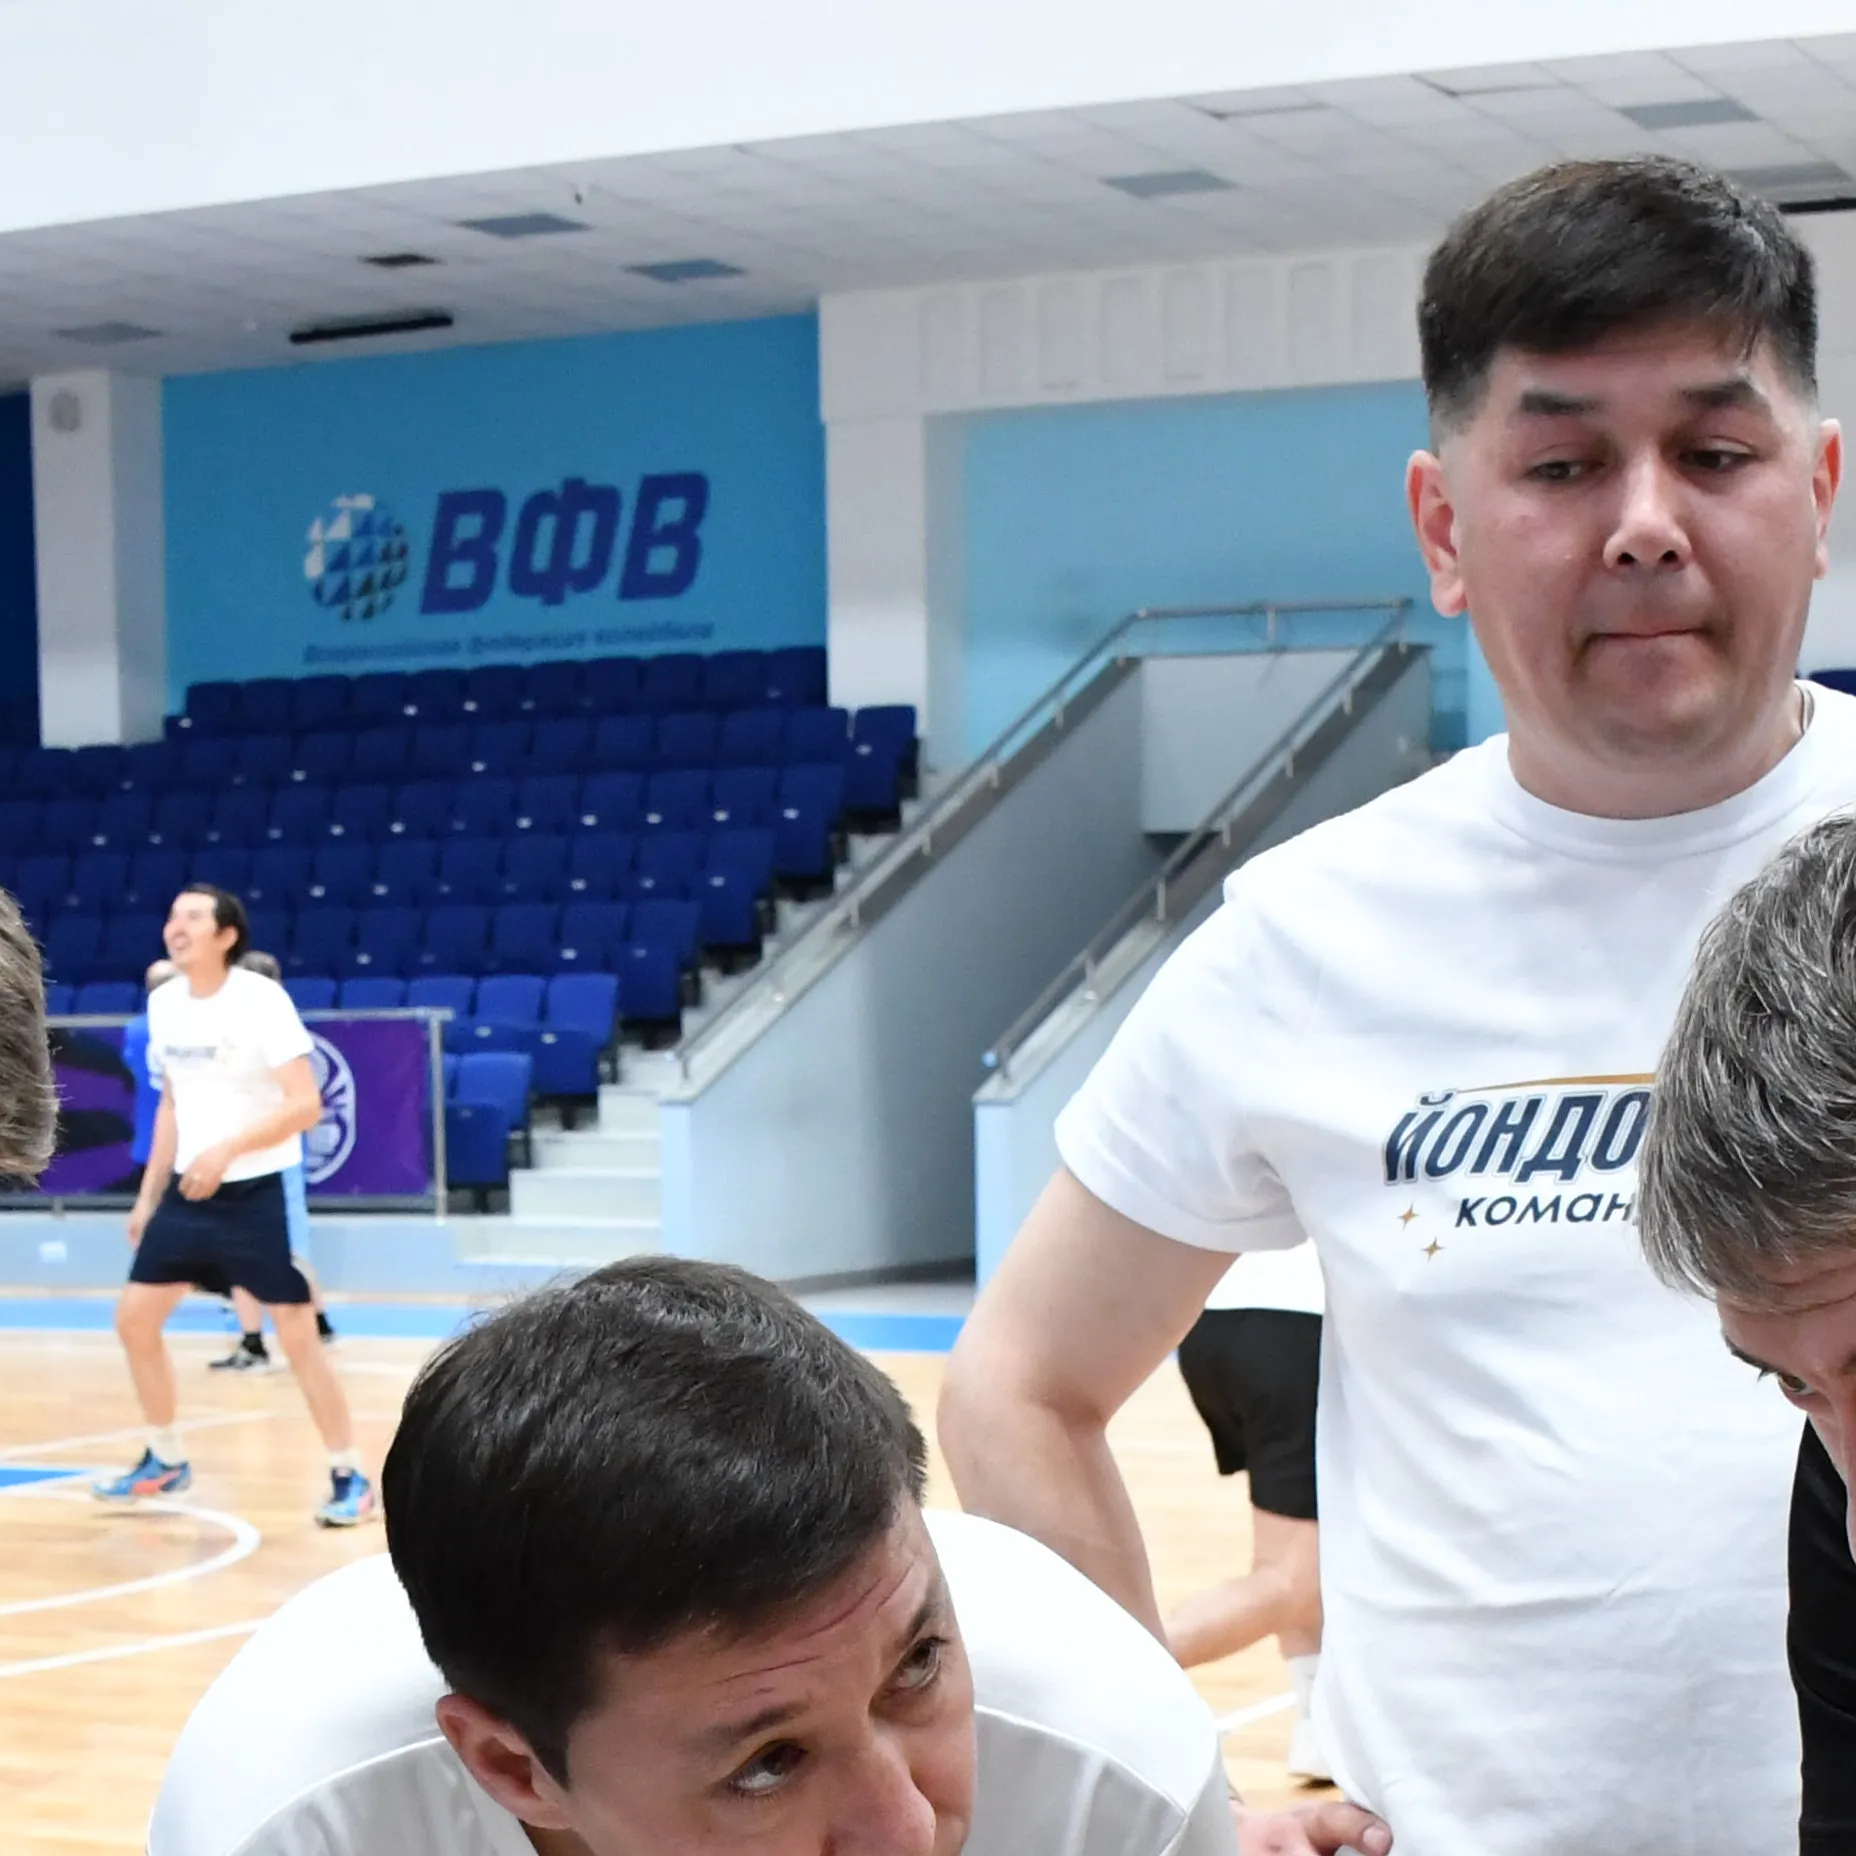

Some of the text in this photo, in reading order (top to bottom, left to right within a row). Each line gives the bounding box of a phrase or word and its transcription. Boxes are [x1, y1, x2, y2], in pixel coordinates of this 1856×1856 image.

[421, 470, 709, 614] ВФВ
[1385, 1092, 1656, 1186] ЙОНДО
[1454, 1192, 1637, 1229] коман
